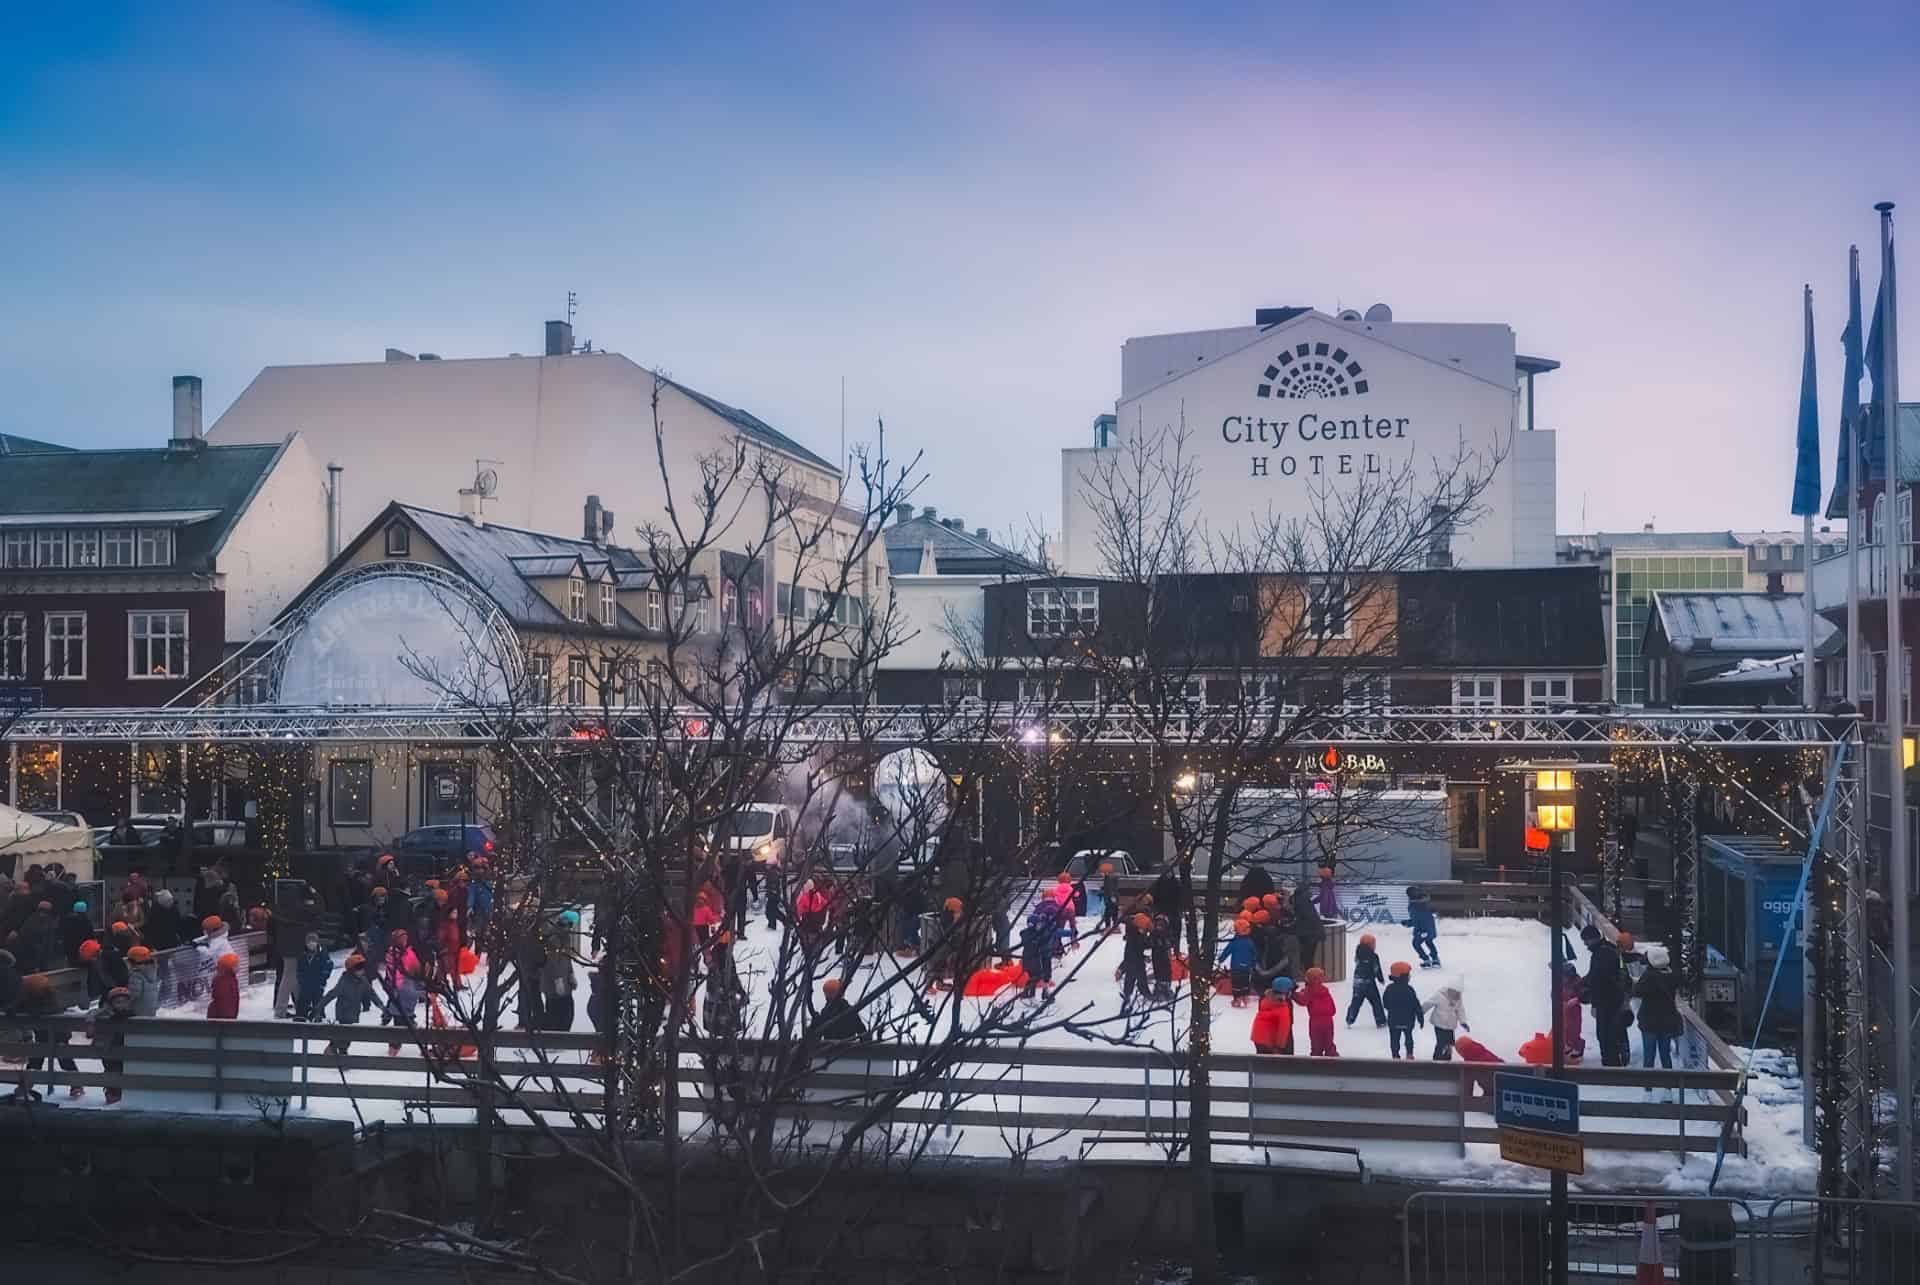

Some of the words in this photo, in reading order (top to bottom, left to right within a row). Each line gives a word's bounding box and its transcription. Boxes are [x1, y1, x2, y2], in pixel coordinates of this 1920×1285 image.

[1222, 415, 1289, 449] City
[1298, 413, 1410, 441] Center
[1251, 454, 1381, 476] HOTEL
